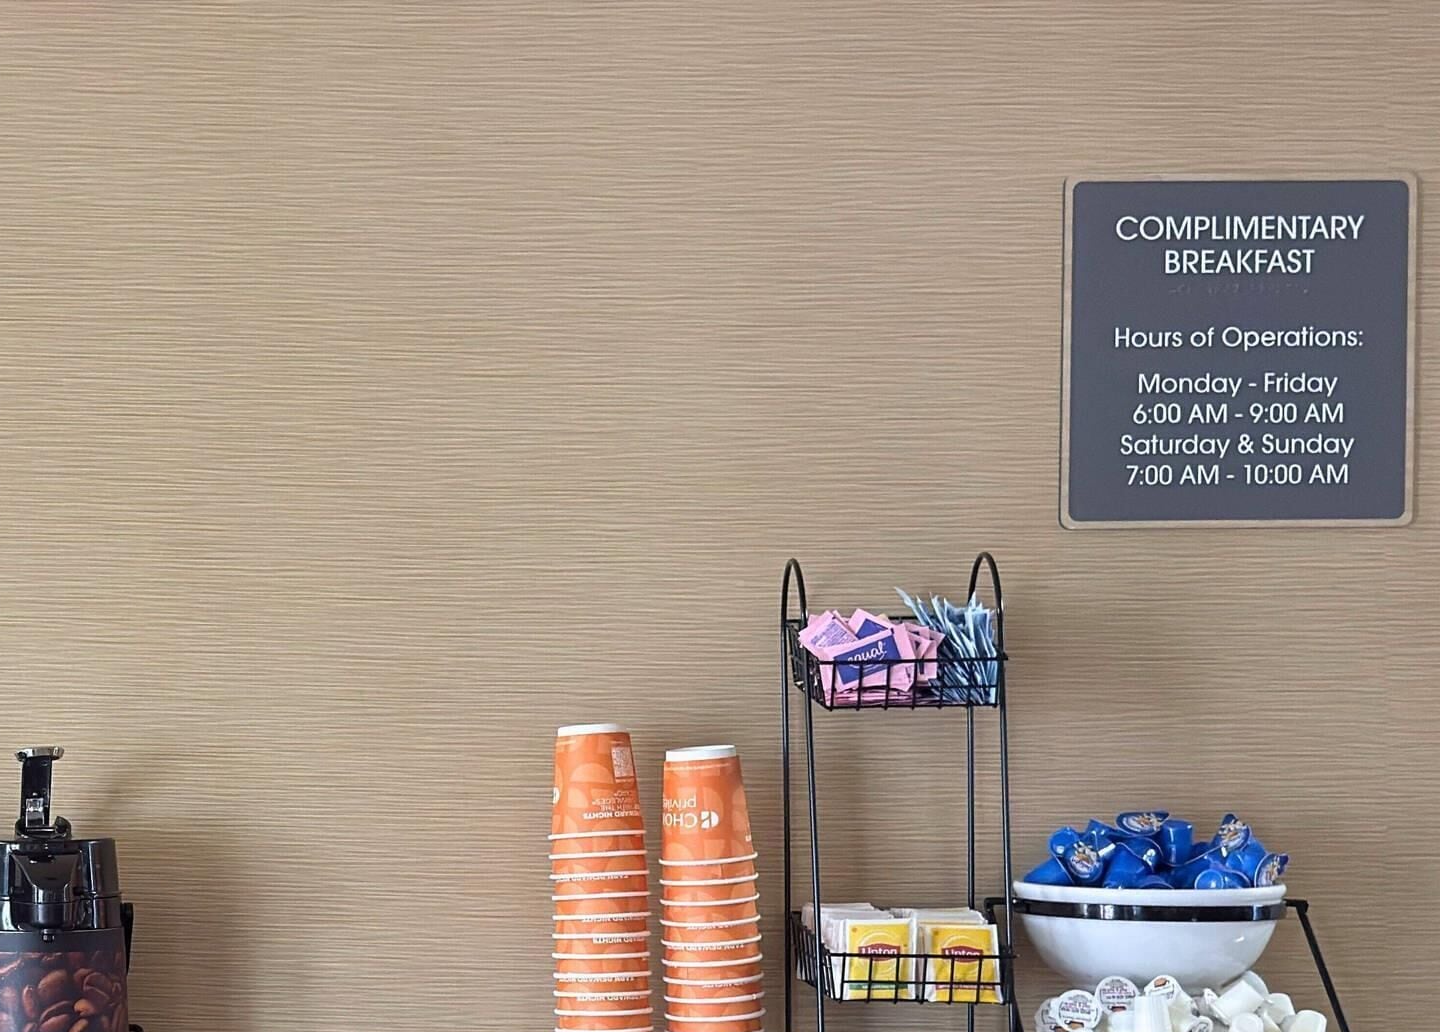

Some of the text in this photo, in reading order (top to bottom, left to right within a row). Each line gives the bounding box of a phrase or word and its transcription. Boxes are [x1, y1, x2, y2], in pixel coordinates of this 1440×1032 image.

[1115, 214, 1365, 241] COMPLIMENTARY
[1164, 248, 1316, 274] BREAKFAST
[1114, 325, 1364, 352] Hours of Operations:
[1138, 372, 1243, 398] Monday
[1264, 372, 1338, 398] Friday
[1132, 402, 1182, 425] 6:00
[1187, 403, 1228, 425] AM
[1249, 402, 1298, 424] 9:00
[1303, 402, 1344, 424] AM
[1120, 432, 1355, 459] Saturday & Sunday
[1126, 464, 1173, 486] 7:00
[1179, 464, 1220, 485] AM
[1243, 463, 1302, 485] 10:00
[1308, 463, 1349, 484] AM
